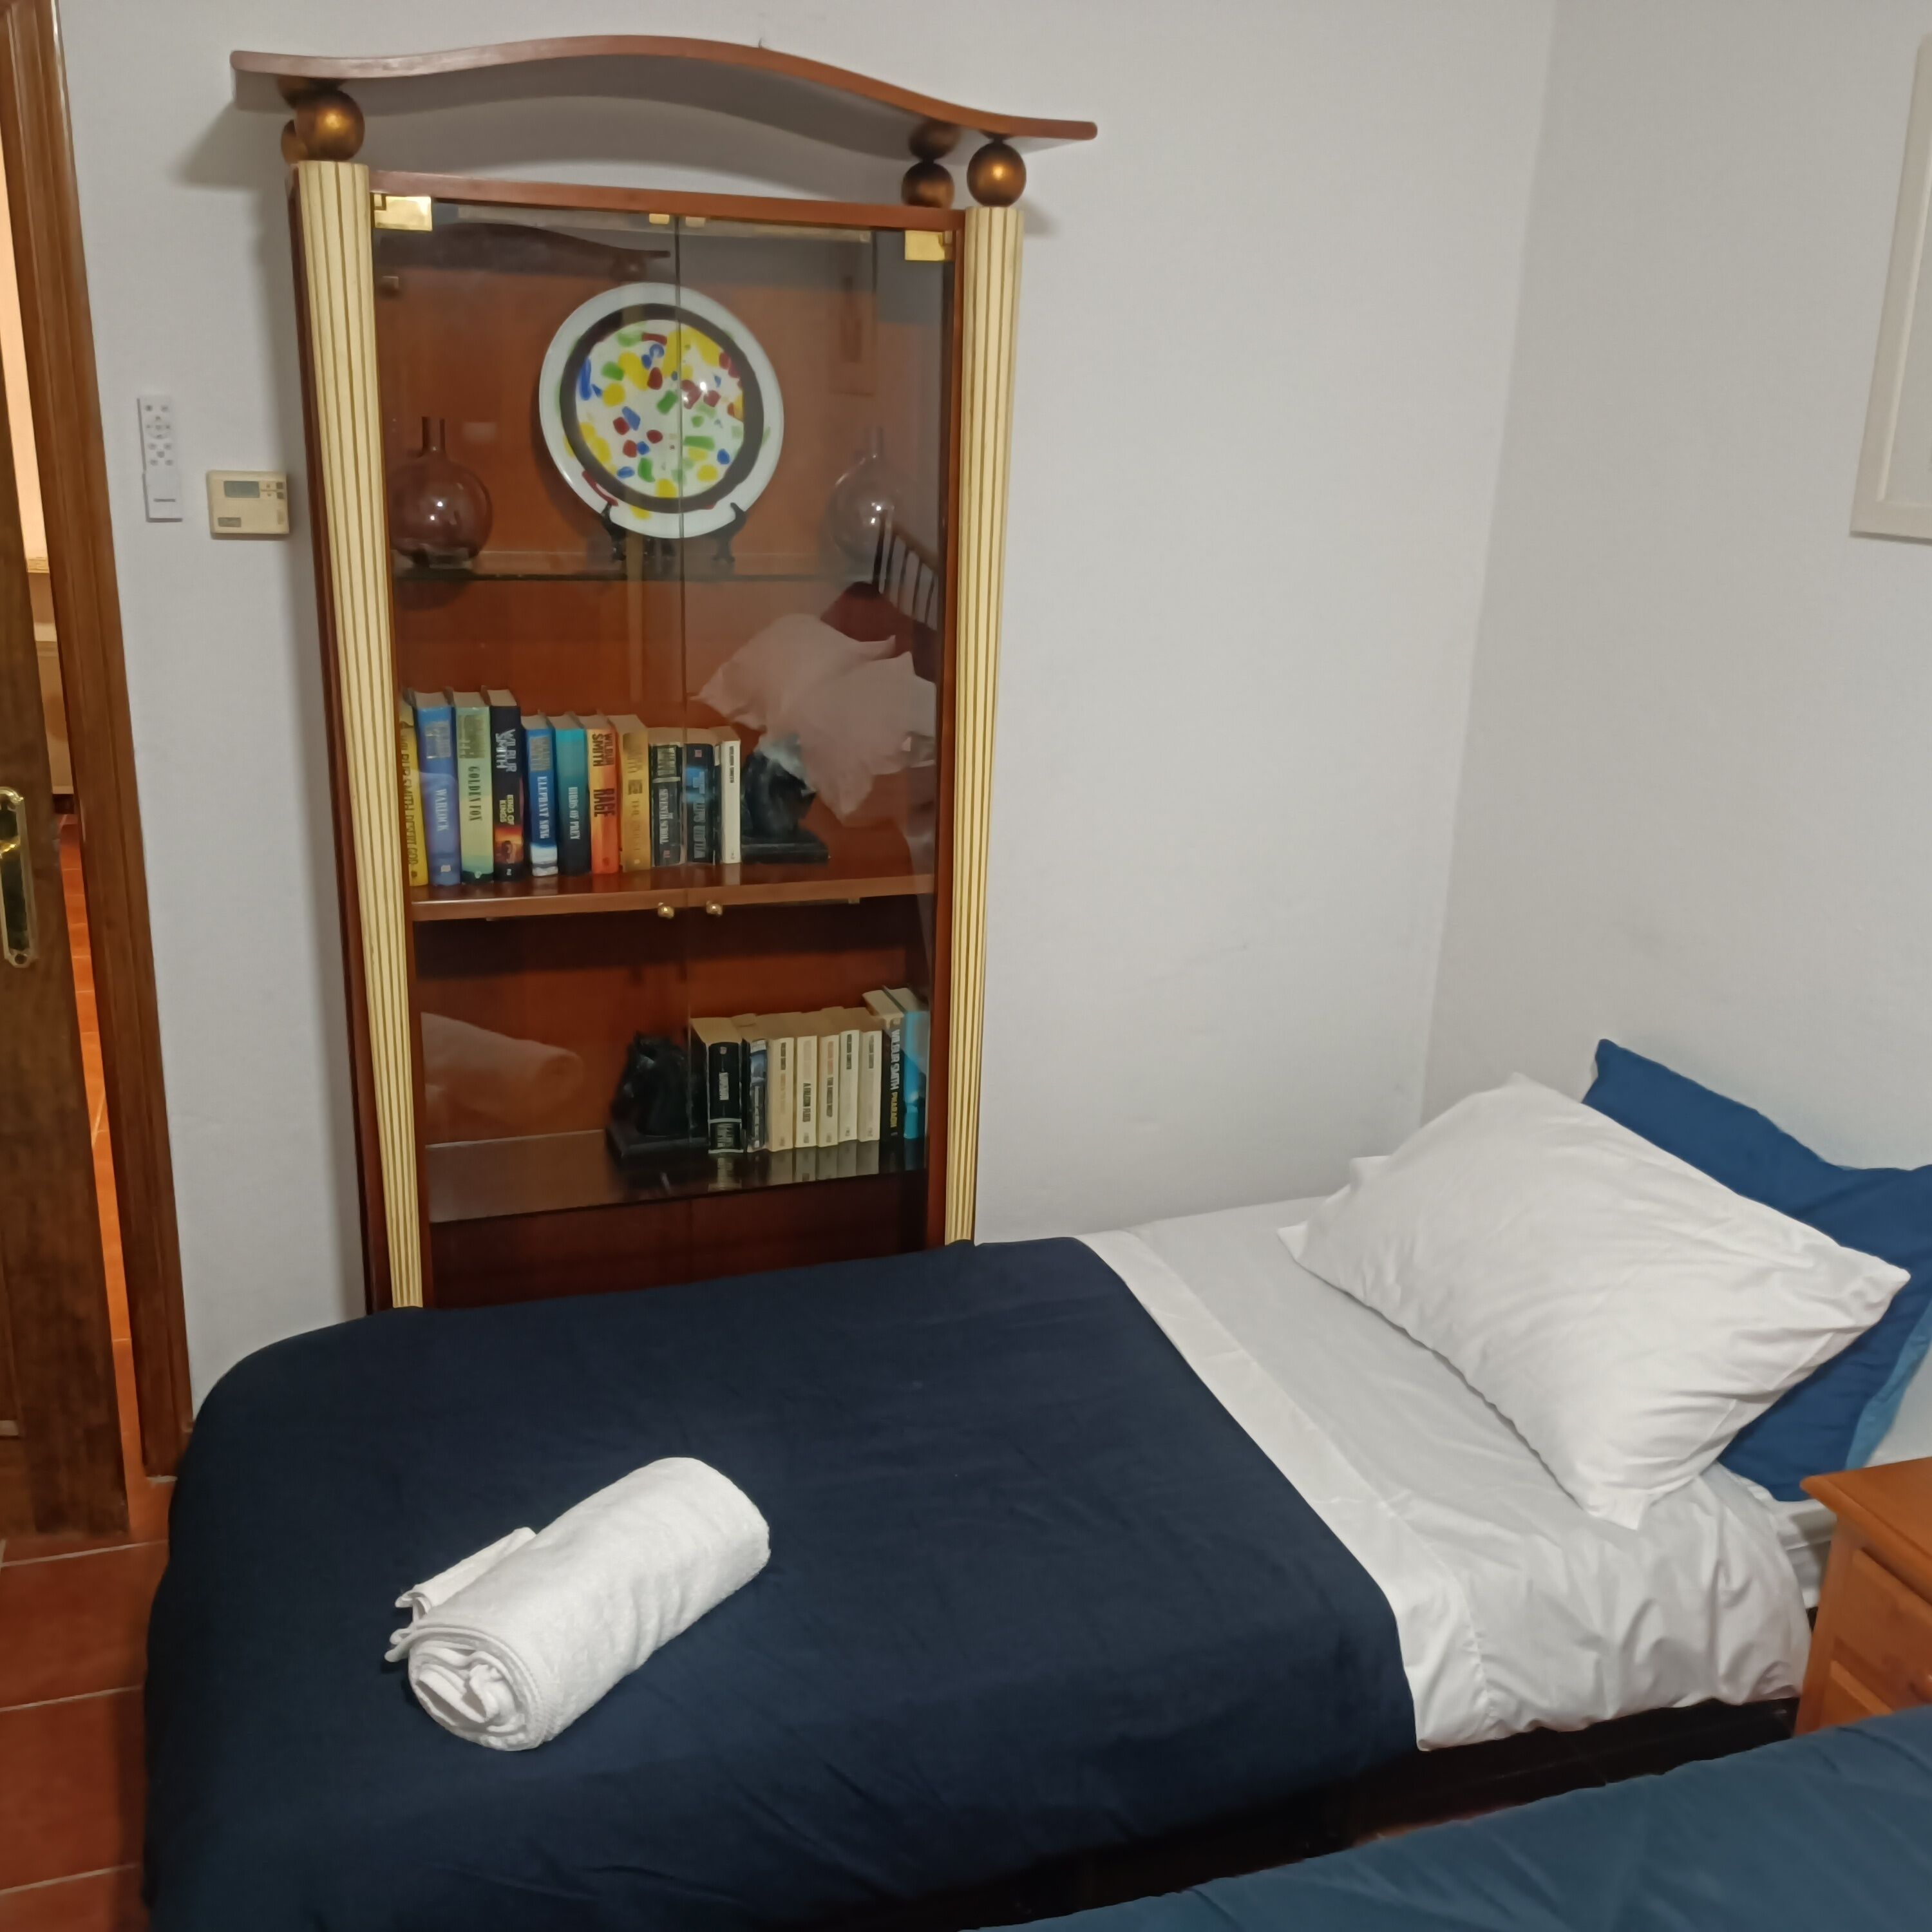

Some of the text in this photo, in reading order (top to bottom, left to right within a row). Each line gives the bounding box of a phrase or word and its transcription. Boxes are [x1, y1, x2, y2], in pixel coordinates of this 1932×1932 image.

[495, 732, 507, 770] SMITH
[506, 728, 517, 773] WILBUR
[592, 733, 603, 767] SMITH
[604, 733, 614, 766] WILBUR
[468, 766, 482, 802] GOLDEN
[537, 776, 549, 817] ELEPHANT
[568, 786, 578, 808] BIRDS
[435, 788, 449, 831] WARLOCK
[469, 805, 482, 822] FOX
[593, 788, 616, 818] RAGE
[569, 821, 580, 840] PREY
[890, 1029, 901, 1090] WILBUR SMITH
